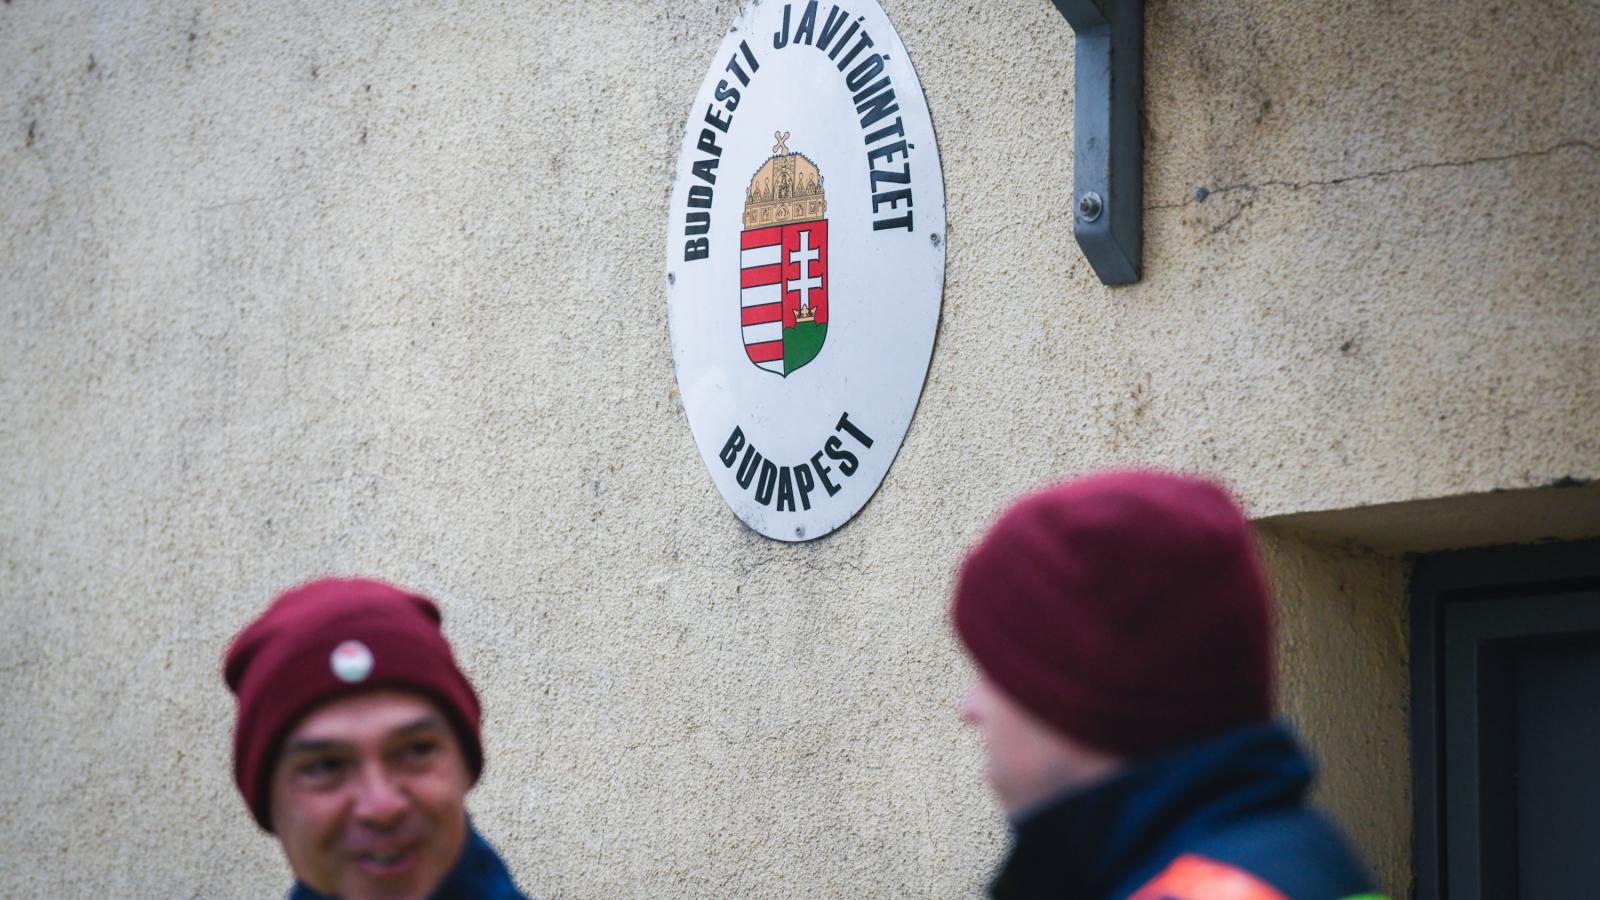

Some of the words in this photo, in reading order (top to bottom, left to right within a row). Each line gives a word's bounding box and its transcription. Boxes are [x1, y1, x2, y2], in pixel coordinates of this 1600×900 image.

[684, 39, 760, 262] BUDAPESTI
[773, 0, 915, 233] JAVÍTÓINTÉZET
[719, 411, 874, 512] BUDAPEST
